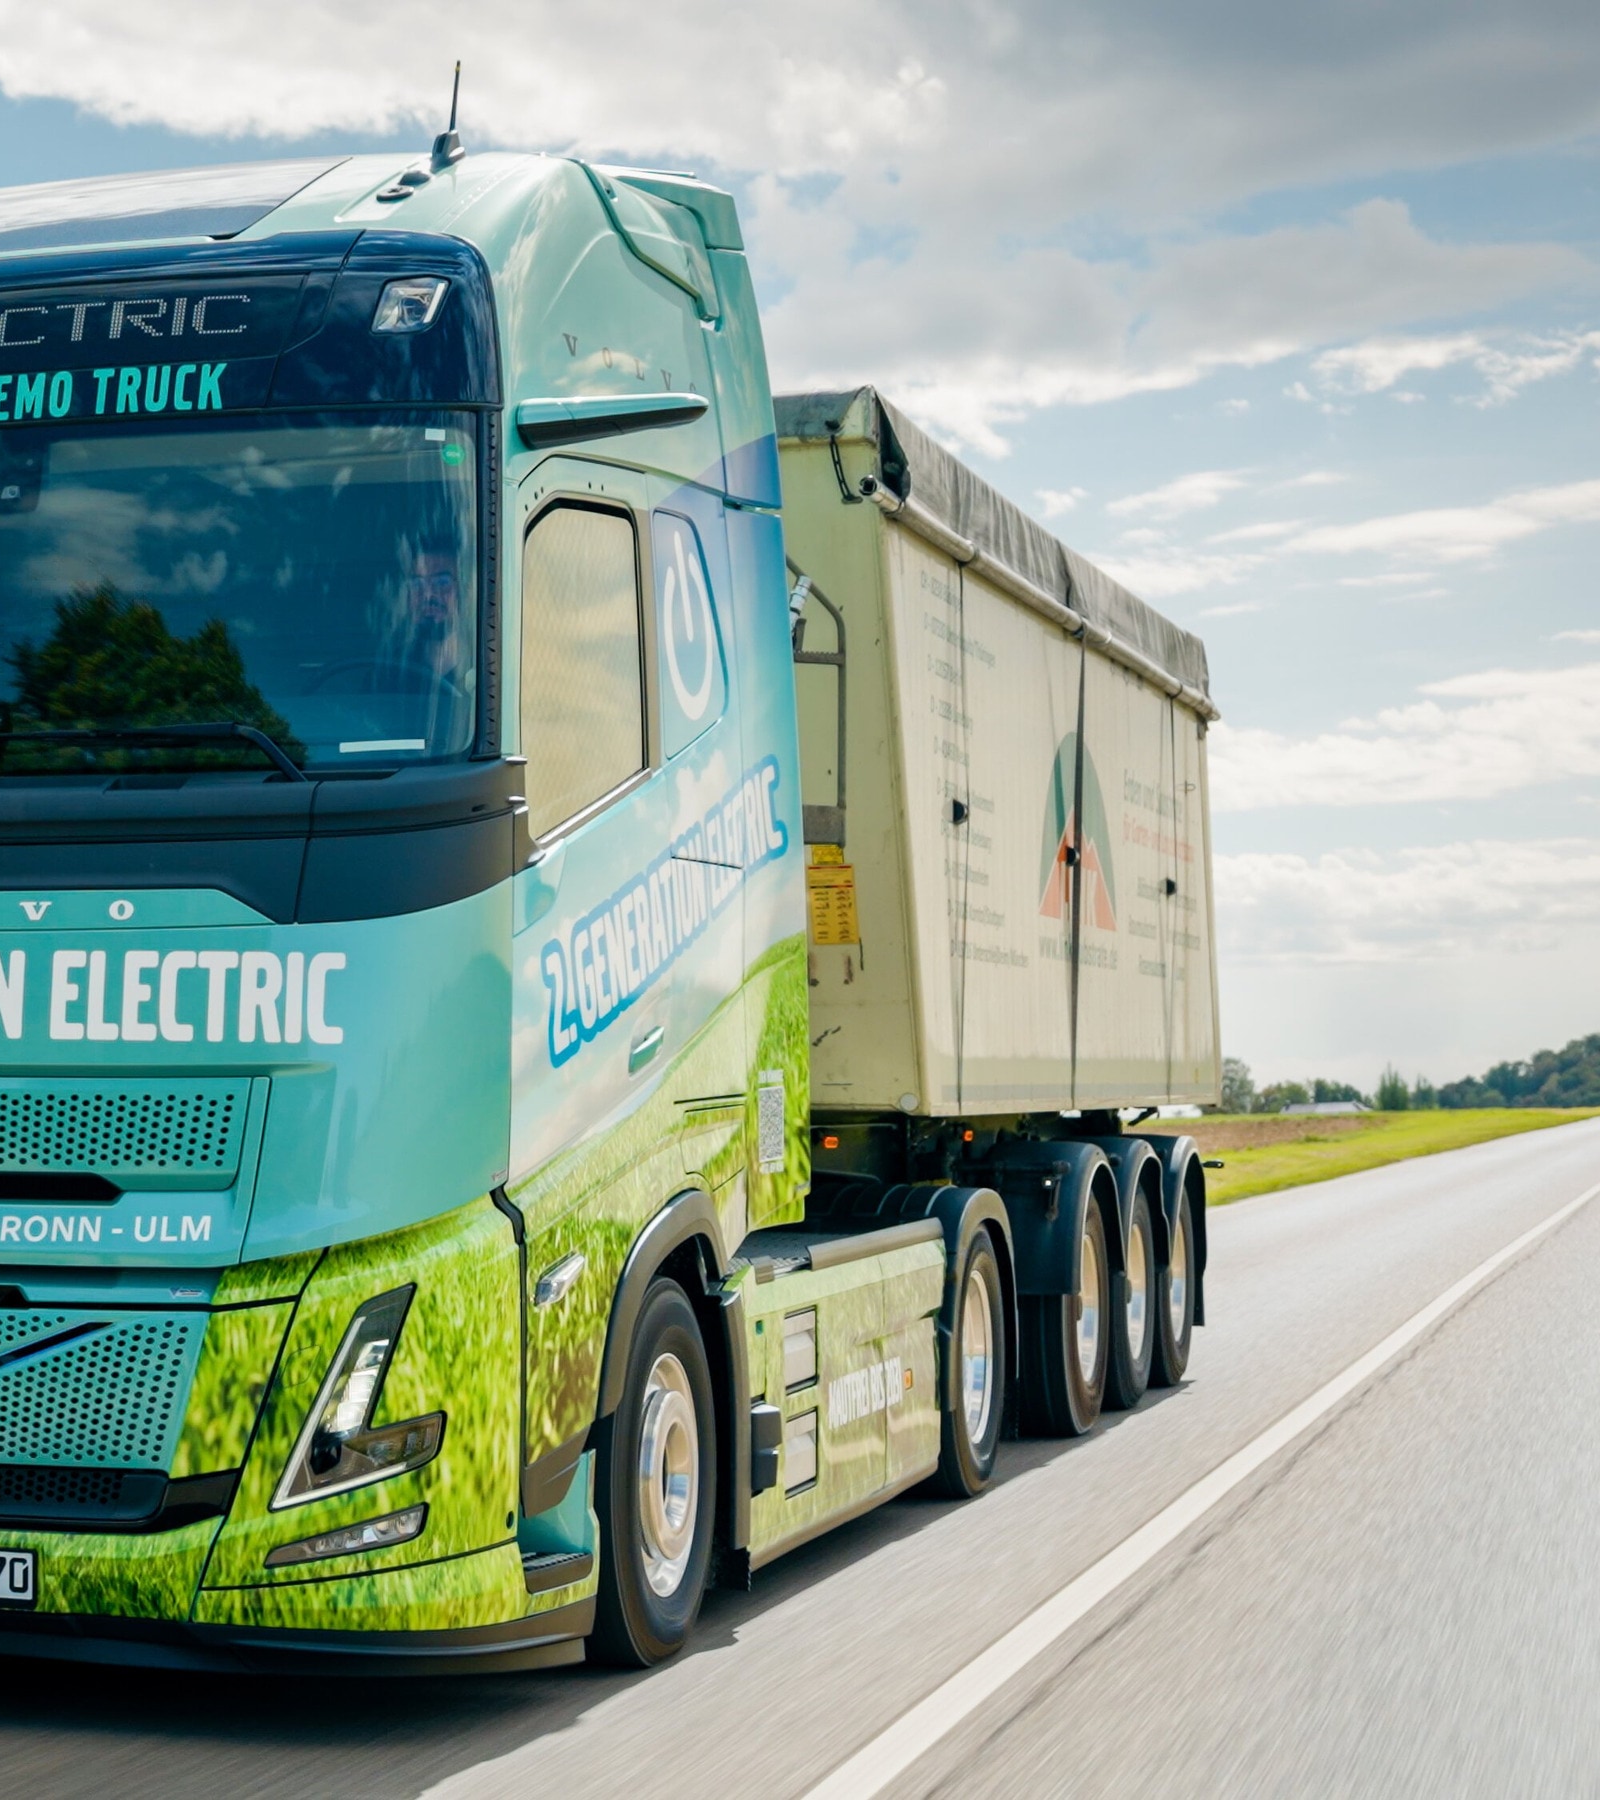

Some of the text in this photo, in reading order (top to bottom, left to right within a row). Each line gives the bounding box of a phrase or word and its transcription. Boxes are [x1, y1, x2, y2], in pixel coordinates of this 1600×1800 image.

[92, 362, 228, 417] TRUCK
[574, 832, 708, 1030] GENERATION
[706, 765, 783, 910] ELECTRIC
[49, 951, 346, 1044] ELECTRIC
[134, 1214, 212, 1242] ULM
